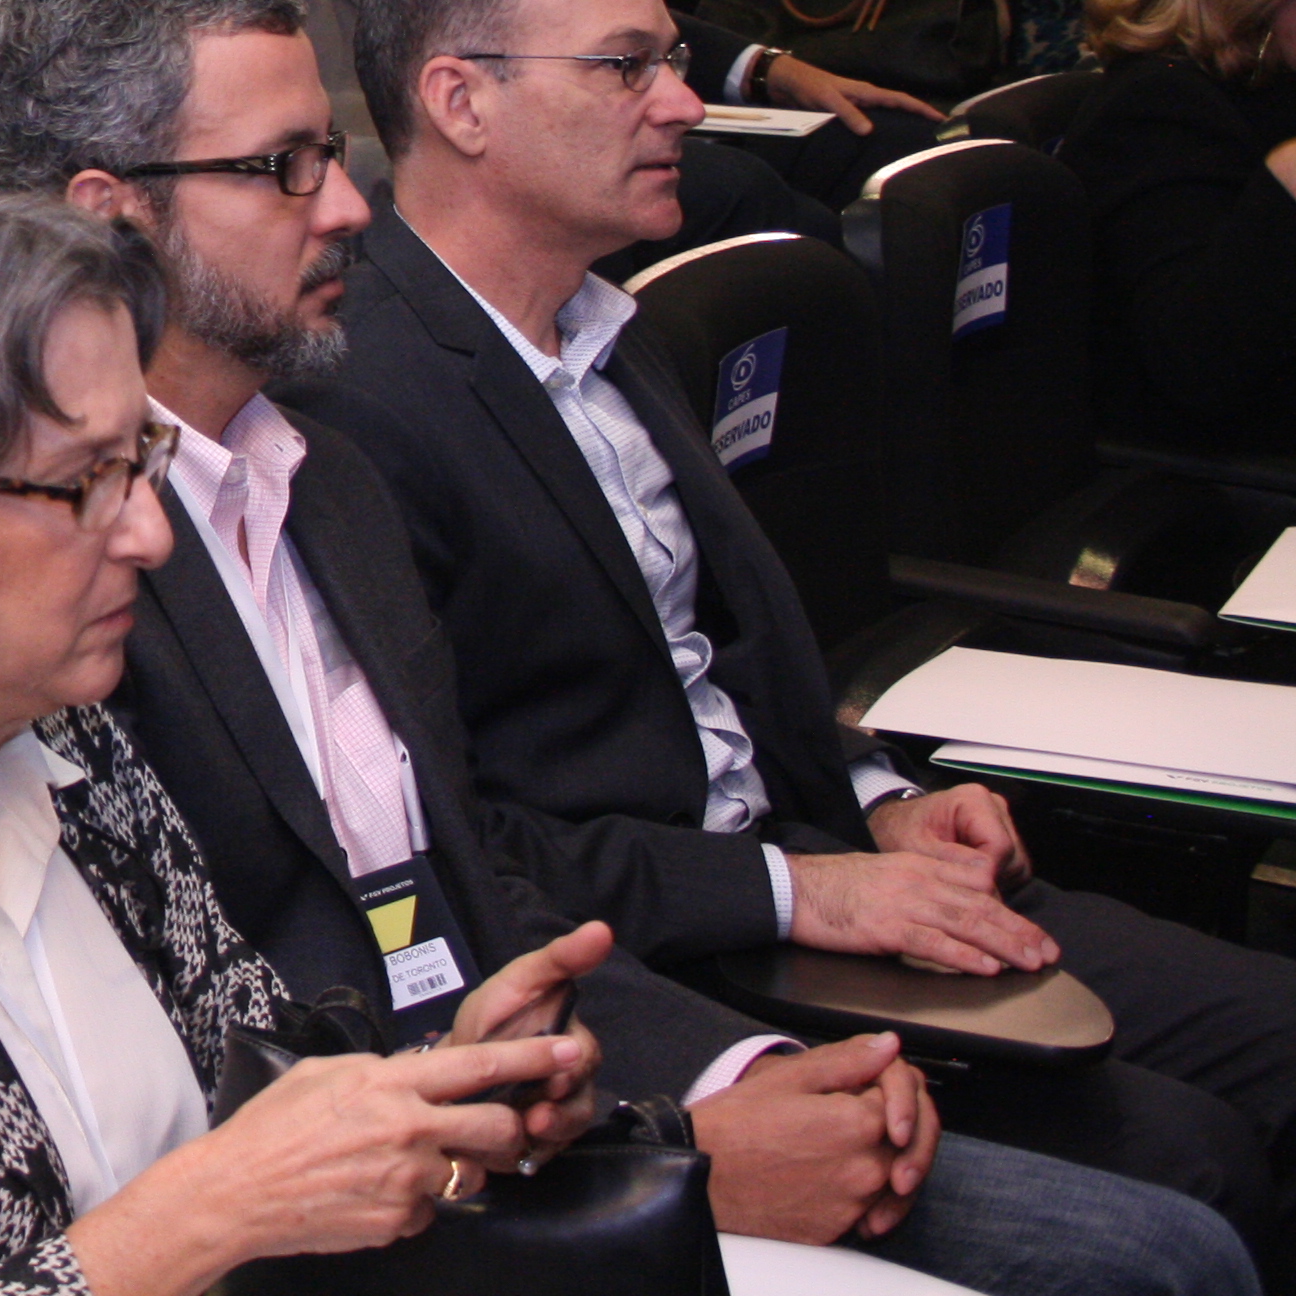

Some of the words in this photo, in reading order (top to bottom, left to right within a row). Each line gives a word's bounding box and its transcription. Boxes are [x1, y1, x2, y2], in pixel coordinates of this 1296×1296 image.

[727, 388, 752, 411] CAPES
[713, 410, 772, 453] ESERVADO
[389, 942, 437, 966] BOBONIS
[391, 972, 406, 984] DE
[405, 958, 448, 978] TORONTO
